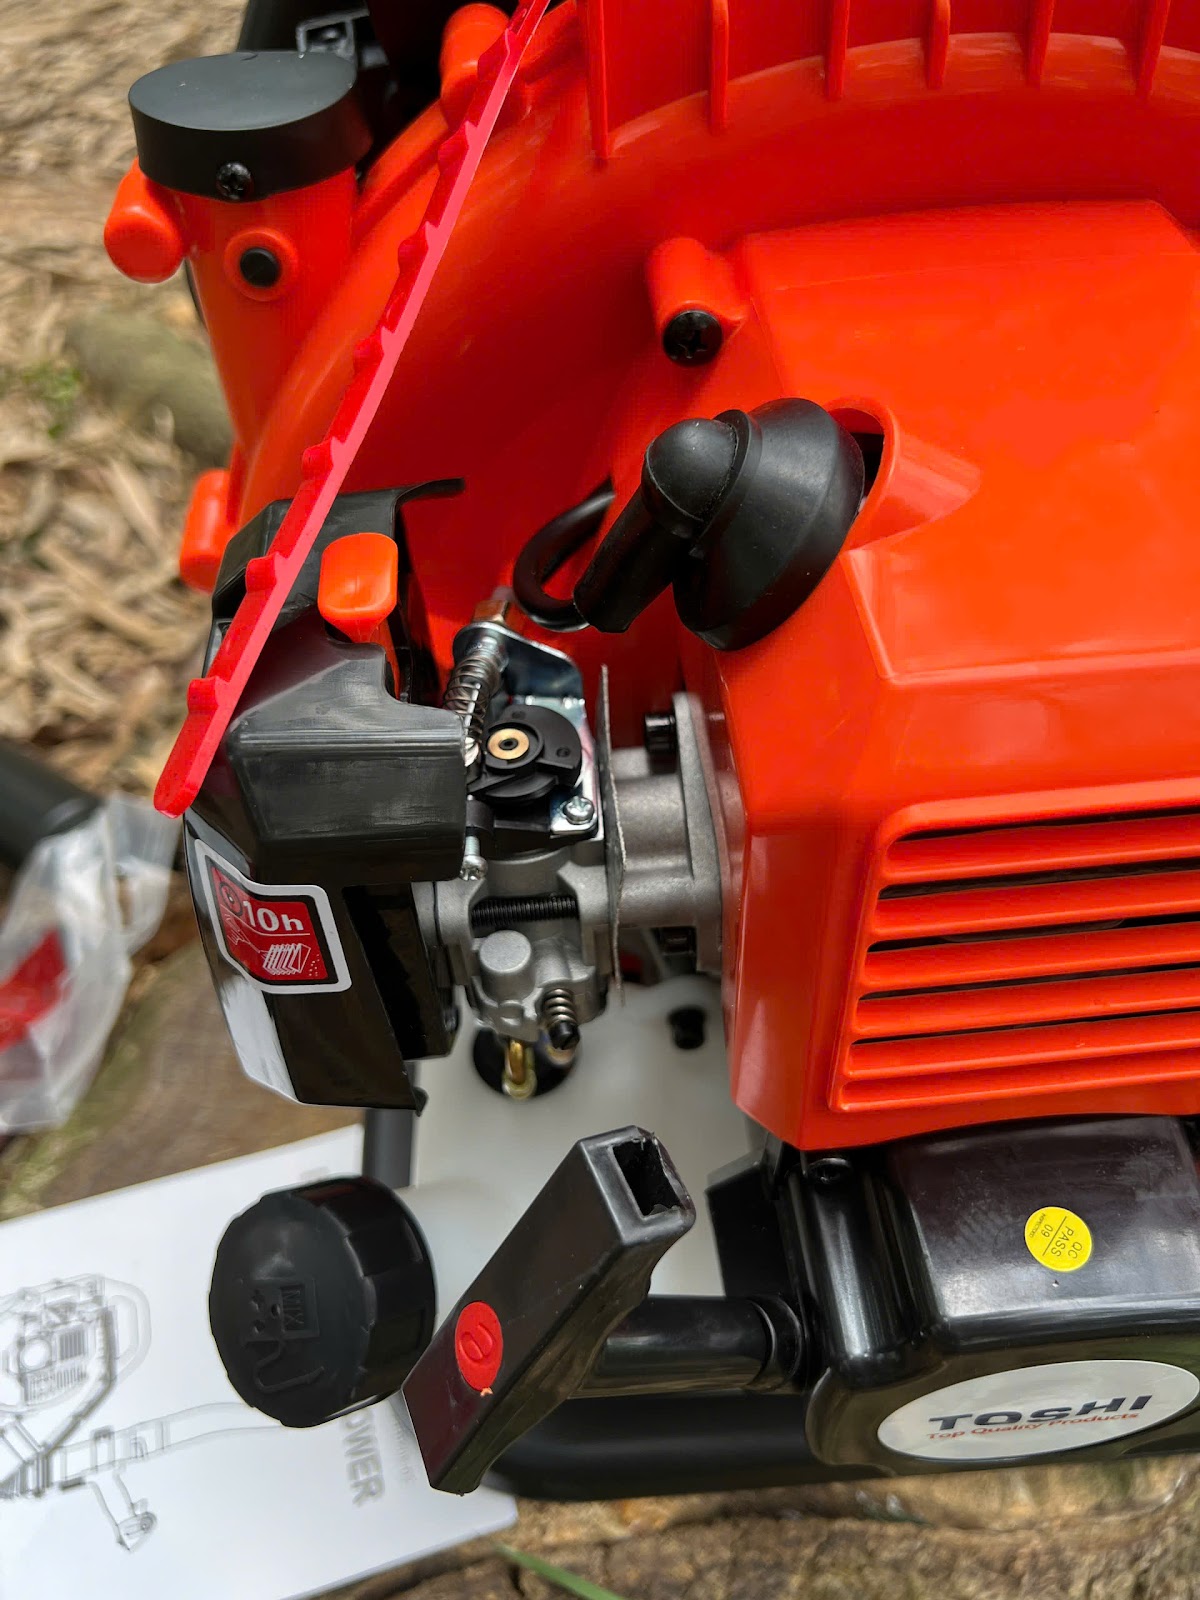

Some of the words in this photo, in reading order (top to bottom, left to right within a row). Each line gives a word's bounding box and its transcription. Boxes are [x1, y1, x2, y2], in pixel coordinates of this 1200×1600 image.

[1041, 1224, 1053, 1238] 09
[1050, 1226, 1075, 1257] PASS
[1068, 1241, 1083, 1259] QC
[926, 1431, 966, 1439] Top
[970, 1422, 1042, 1435] Quality
[1048, 1413, 1140, 1426] Products
[928, 1395, 1152, 1431] TOSHI
